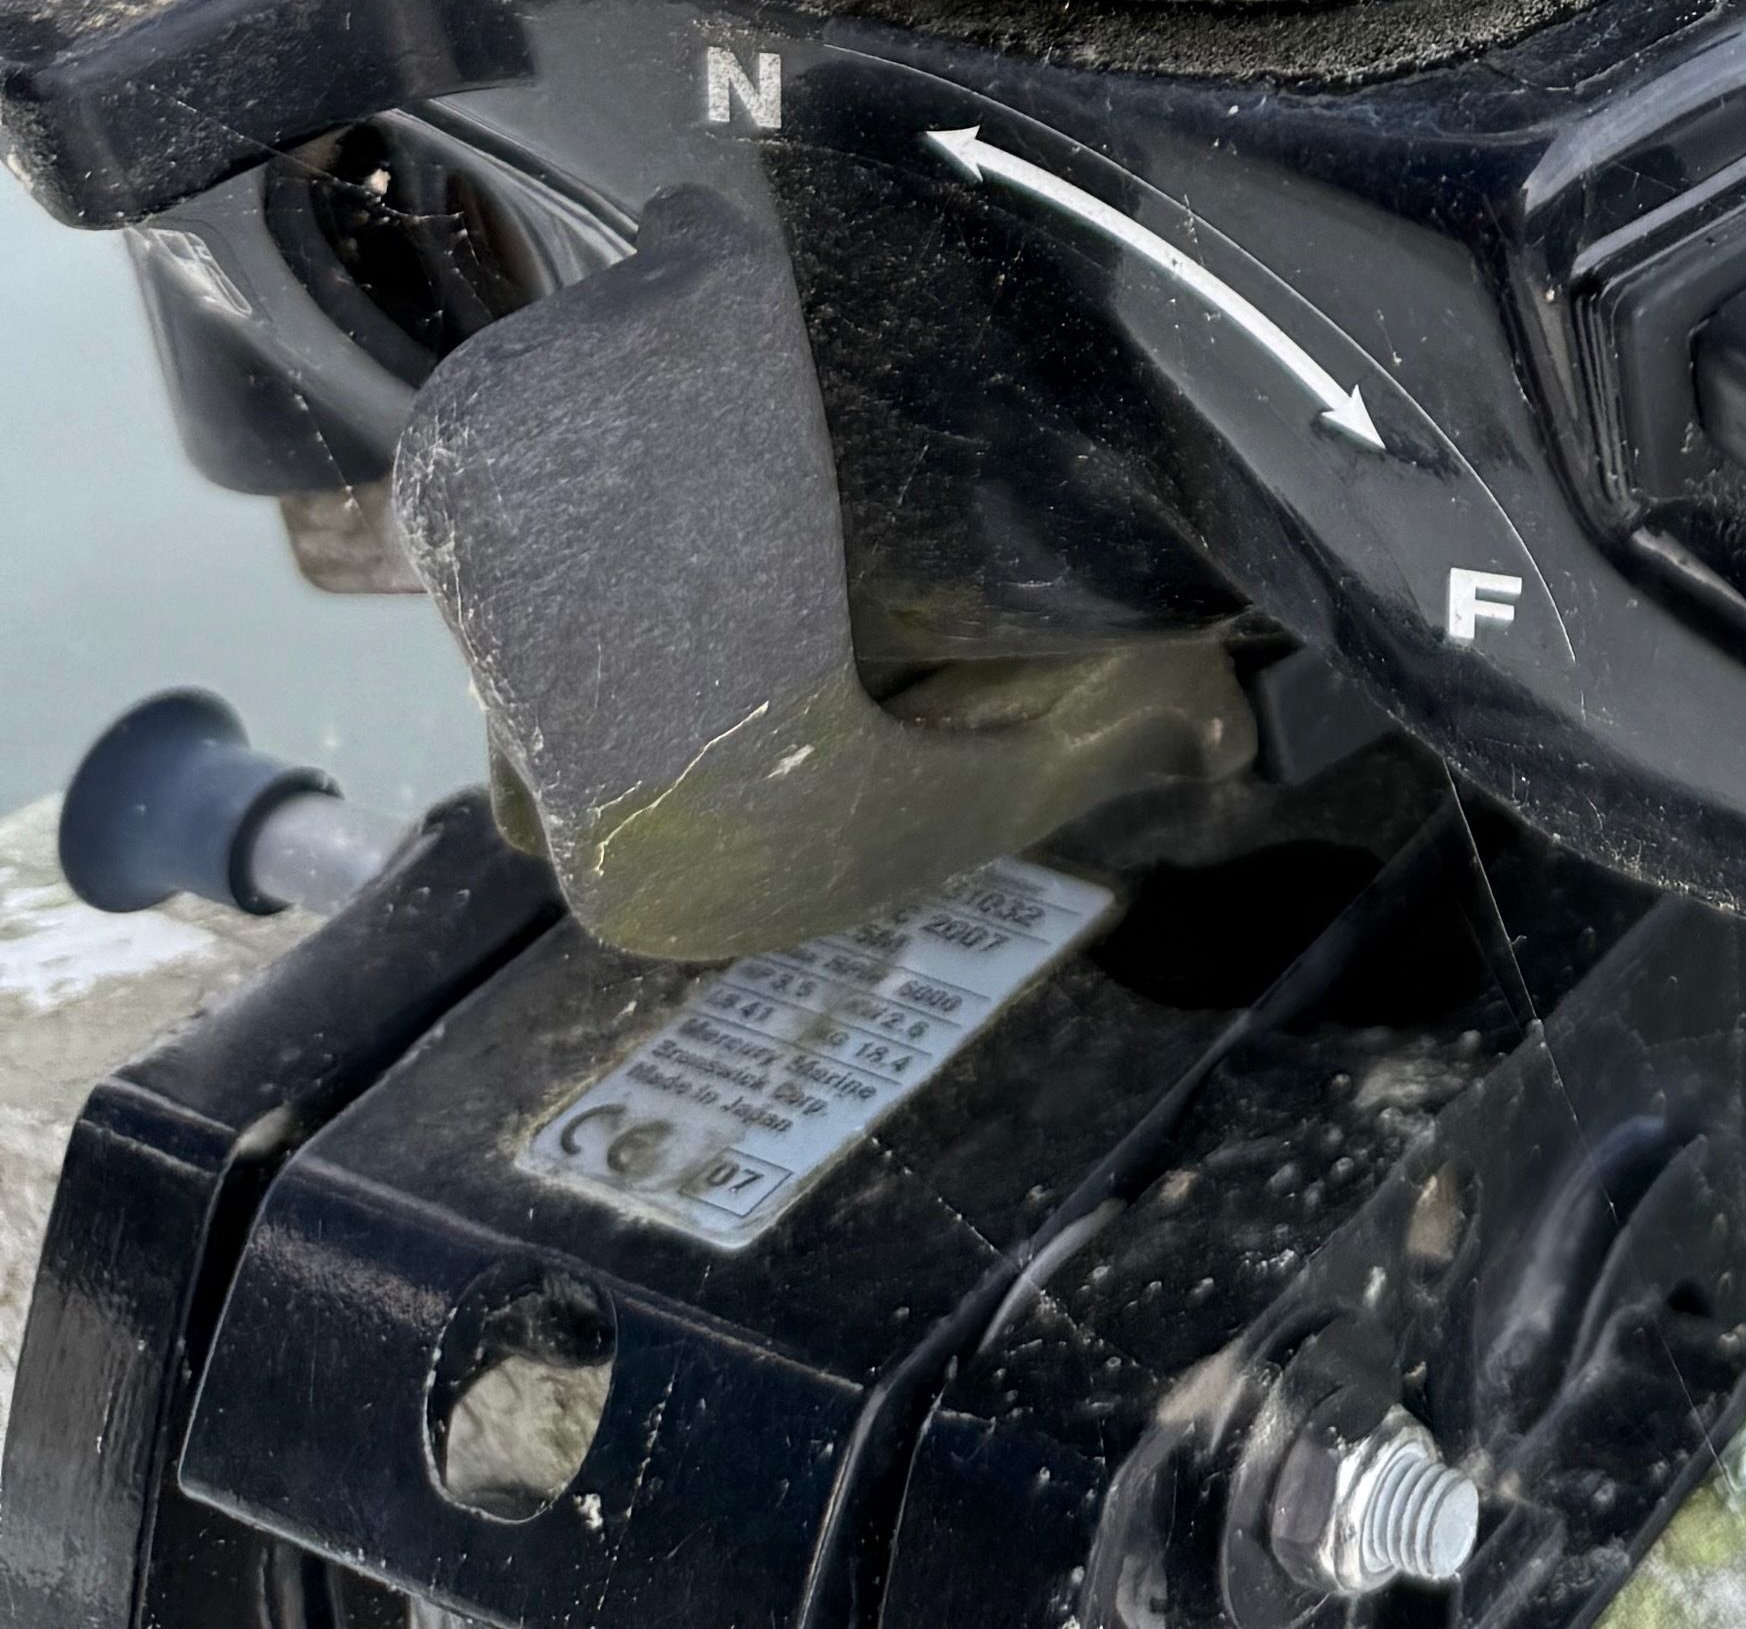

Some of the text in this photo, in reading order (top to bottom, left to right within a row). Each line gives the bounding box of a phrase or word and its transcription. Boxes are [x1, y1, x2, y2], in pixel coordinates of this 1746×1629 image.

[706, 46, 782, 129] N
[1447, 567, 1523, 639] F
[923, 913, 1008, 954] 2007
[674, 1017, 883, 1101] Mercury Marine
[853, 1041, 914, 1072] 18.4
[720, 1095, 798, 1133] Japan
[706, 1162, 765, 1195] 07
